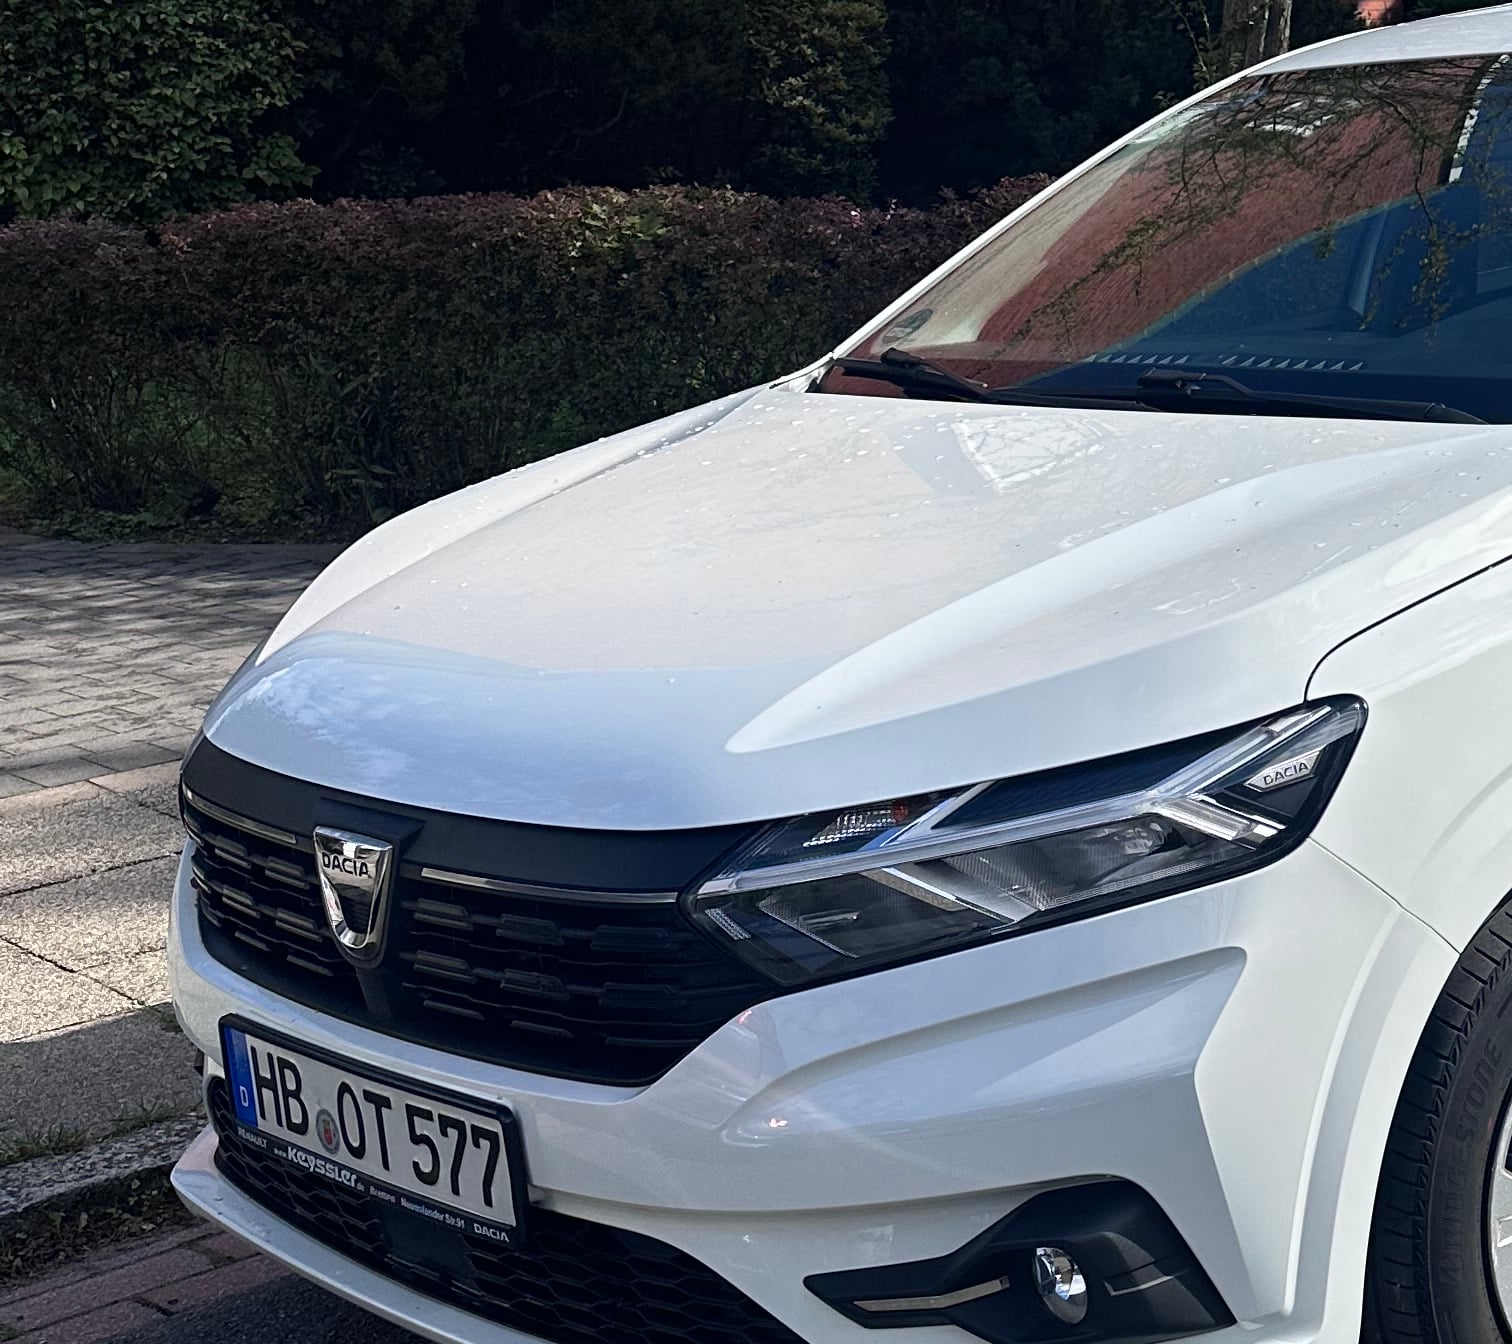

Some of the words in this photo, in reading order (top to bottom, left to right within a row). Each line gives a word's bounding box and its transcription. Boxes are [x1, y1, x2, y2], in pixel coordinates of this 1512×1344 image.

[1263, 762, 1309, 786] DACIA
[321, 851, 372, 879] DACIA
[239, 1085, 249, 1107] D
[250, 1045, 309, 1136] HB
[337, 1081, 392, 1172] OT
[405, 1103, 500, 1208] 577
[473, 1222, 510, 1243] DACIA
